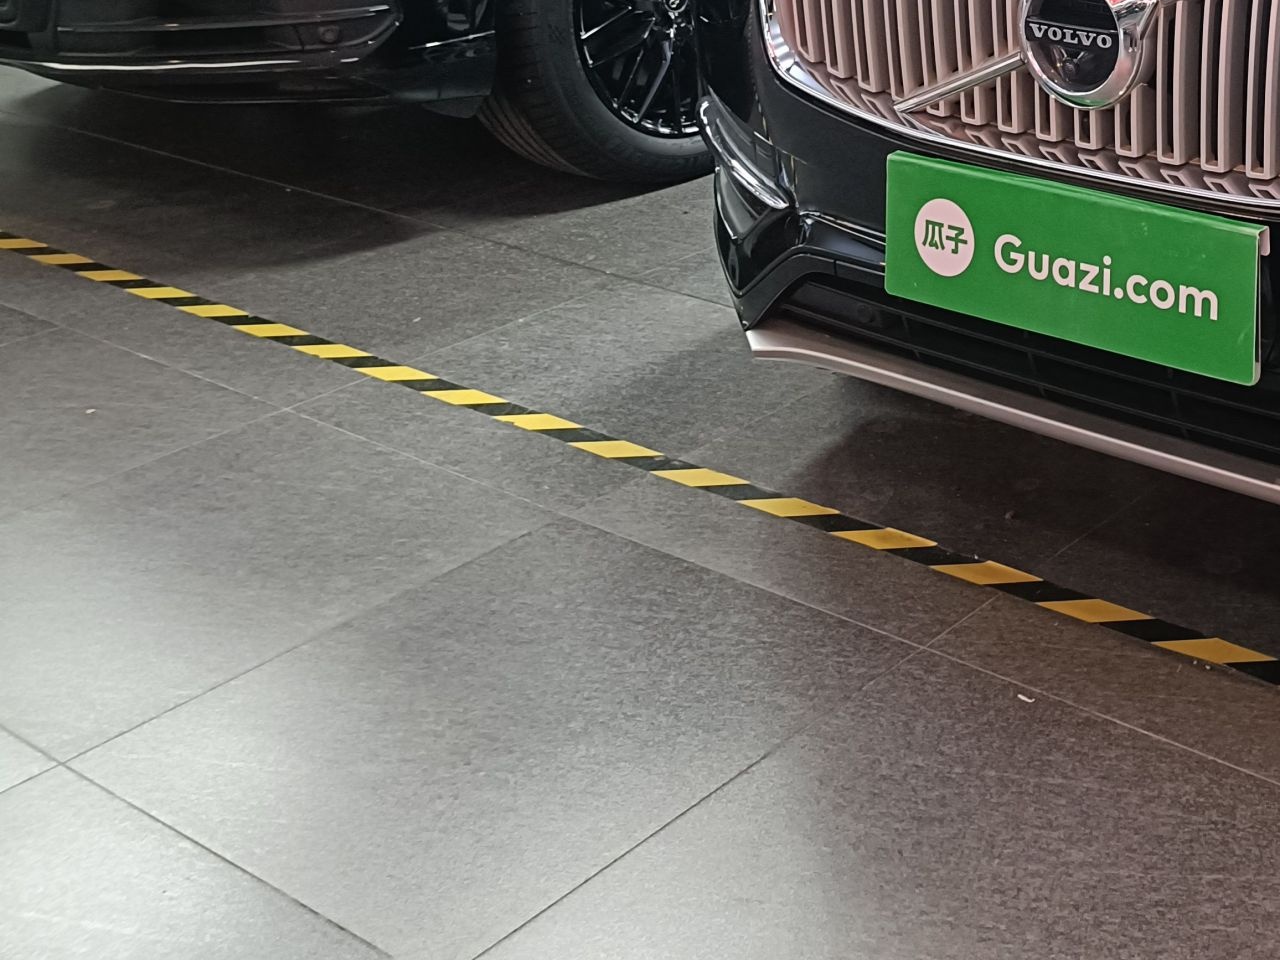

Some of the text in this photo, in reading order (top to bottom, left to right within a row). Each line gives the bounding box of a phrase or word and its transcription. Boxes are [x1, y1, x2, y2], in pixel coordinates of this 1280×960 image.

[1029, 23, 1112, 48] VOLVO
[922, 219, 968, 255] 瓜子
[994, 233, 1219, 321] Guazi.com
